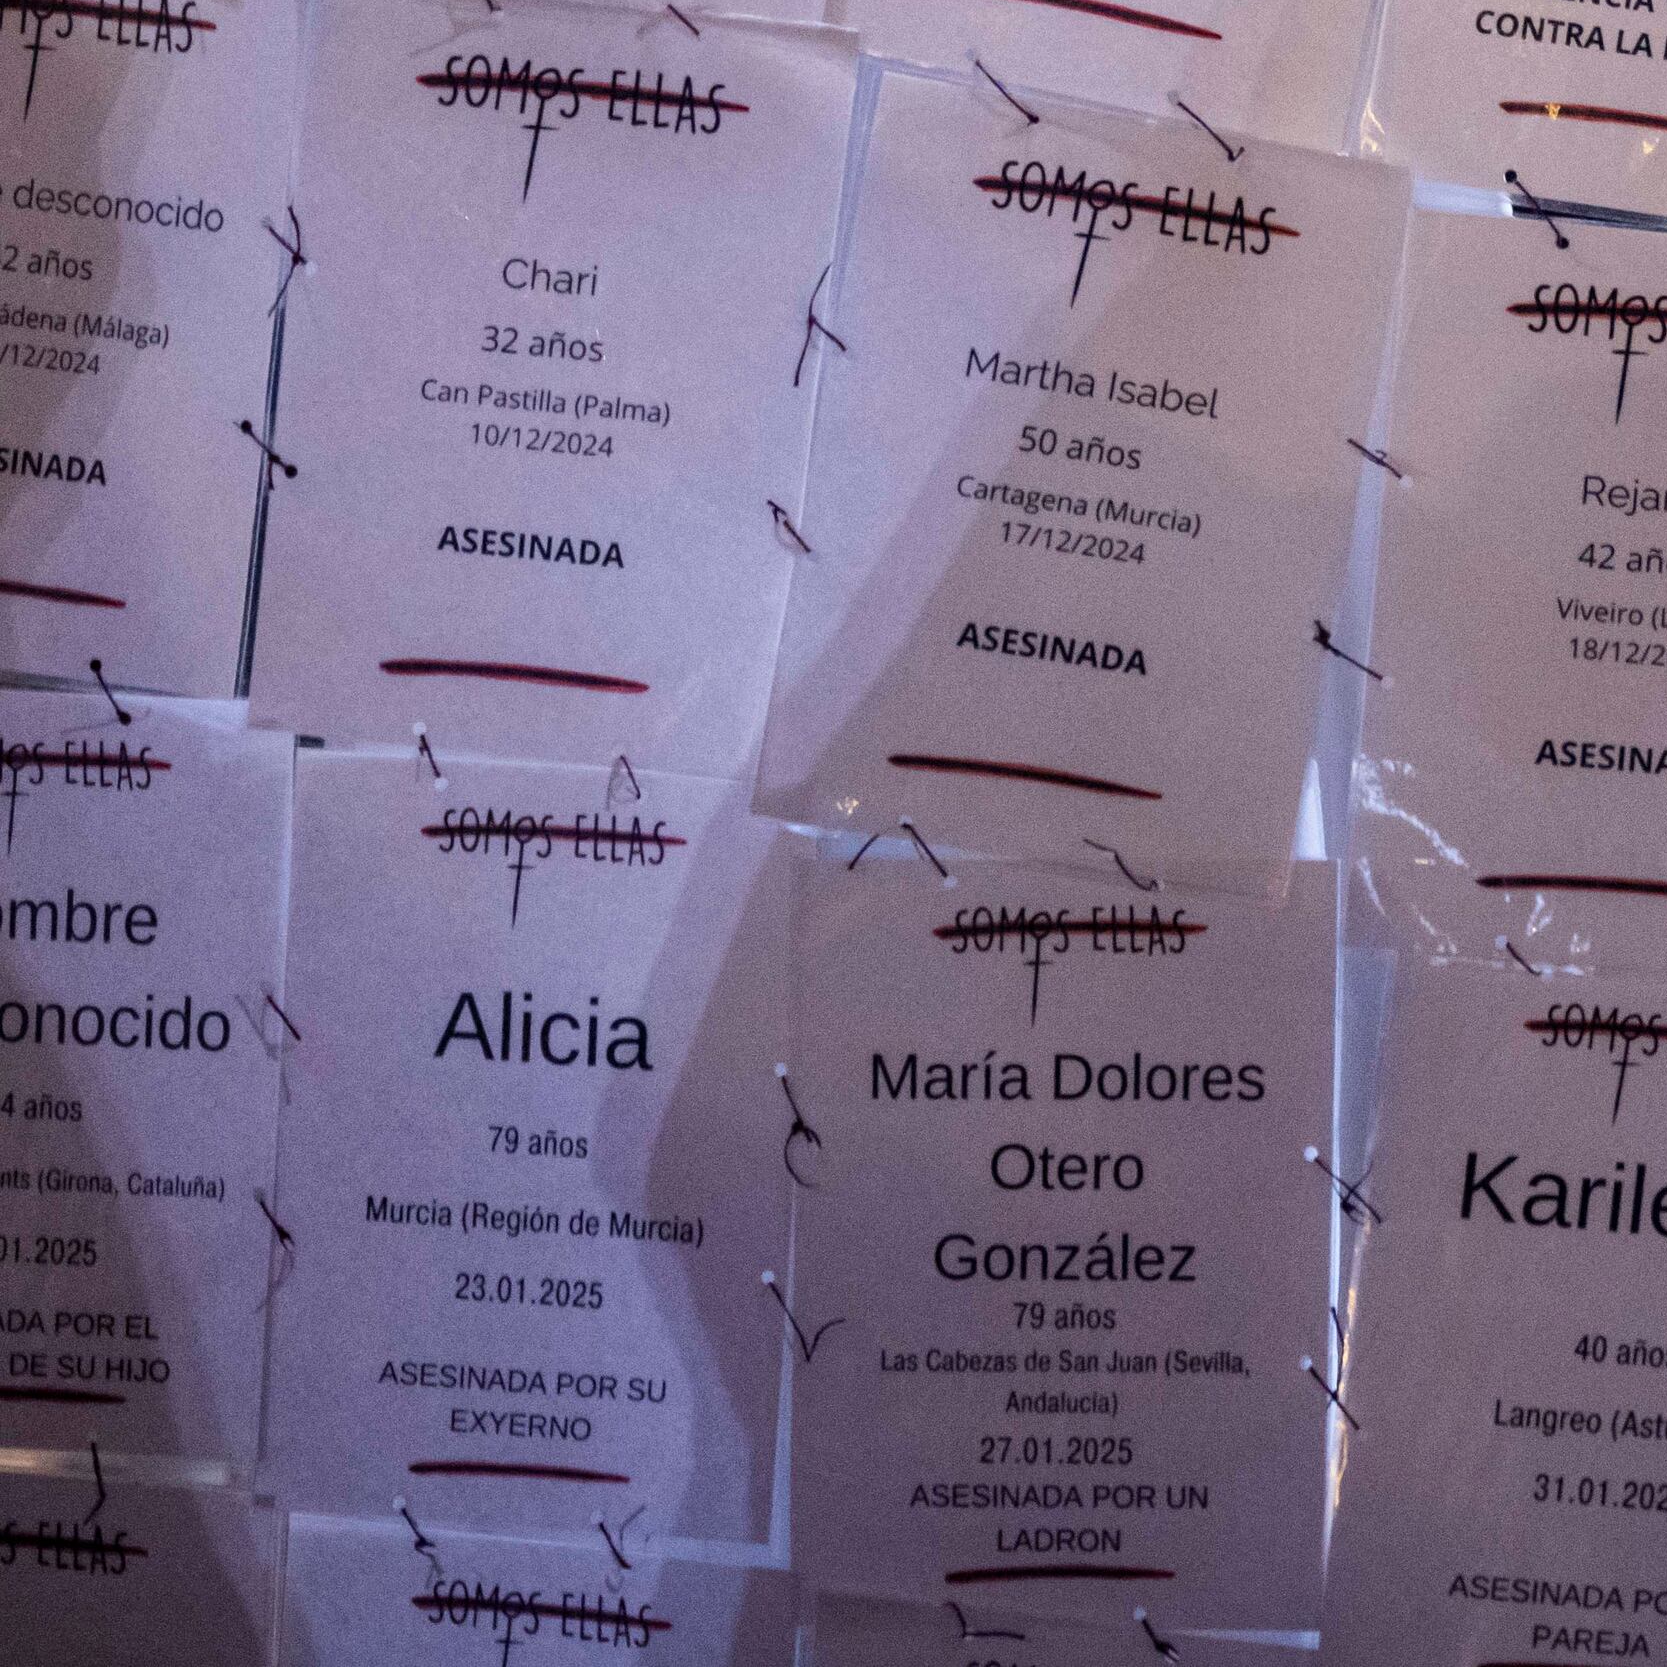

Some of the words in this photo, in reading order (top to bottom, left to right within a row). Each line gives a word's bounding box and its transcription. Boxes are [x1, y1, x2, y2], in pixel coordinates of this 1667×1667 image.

[1474, 9, 1605, 51] CONTRA
[1615, 30, 1653, 58] LA
[12, 179, 226, 234] desconocido
[501, 257, 598, 296] Chari
[419, 377, 470, 404] Can
[476, 383, 567, 414] Pastilla
[573, 394, 672, 428] (Palma)
[964, 346, 1096, 398] Martha
[1107, 371, 1219, 420] Isabel
[472, 422, 614, 458] 10/12/2024
[955, 474, 1089, 516] Cartagena
[1095, 498, 1203, 539] (Murcia)
[1002, 520, 1146, 565] 17/12/2024
[1556, 598, 1644, 626] Viveiro
[434, 991, 653, 1072] Alicia
[871, 1050, 1032, 1101] María
[1053, 1051, 1266, 1103] Dolores
[989, 1142, 1145, 1192] Otero
[365, 1194, 452, 1227] Murcia
[460, 1201, 560, 1238] (Región
[568, 1209, 600, 1237] de
[609, 1211, 705, 1249] Murcia)
[933, 1232, 1197, 1283] González
[454, 1271, 604, 1311] 23.01.2025
[9, 1352, 45, 1378] DE
[57, 1354, 96, 1381] SU
[105, 1357, 171, 1386] HIJO
[449, 1408, 593, 1442] EXYERNO
[1493, 1398, 1603, 1438] Langreo
[979, 1435, 1134, 1466] 27.01.2025
[996, 1528, 1122, 1553] LADRON
[1531, 1624, 1650, 1657] PAREJA
